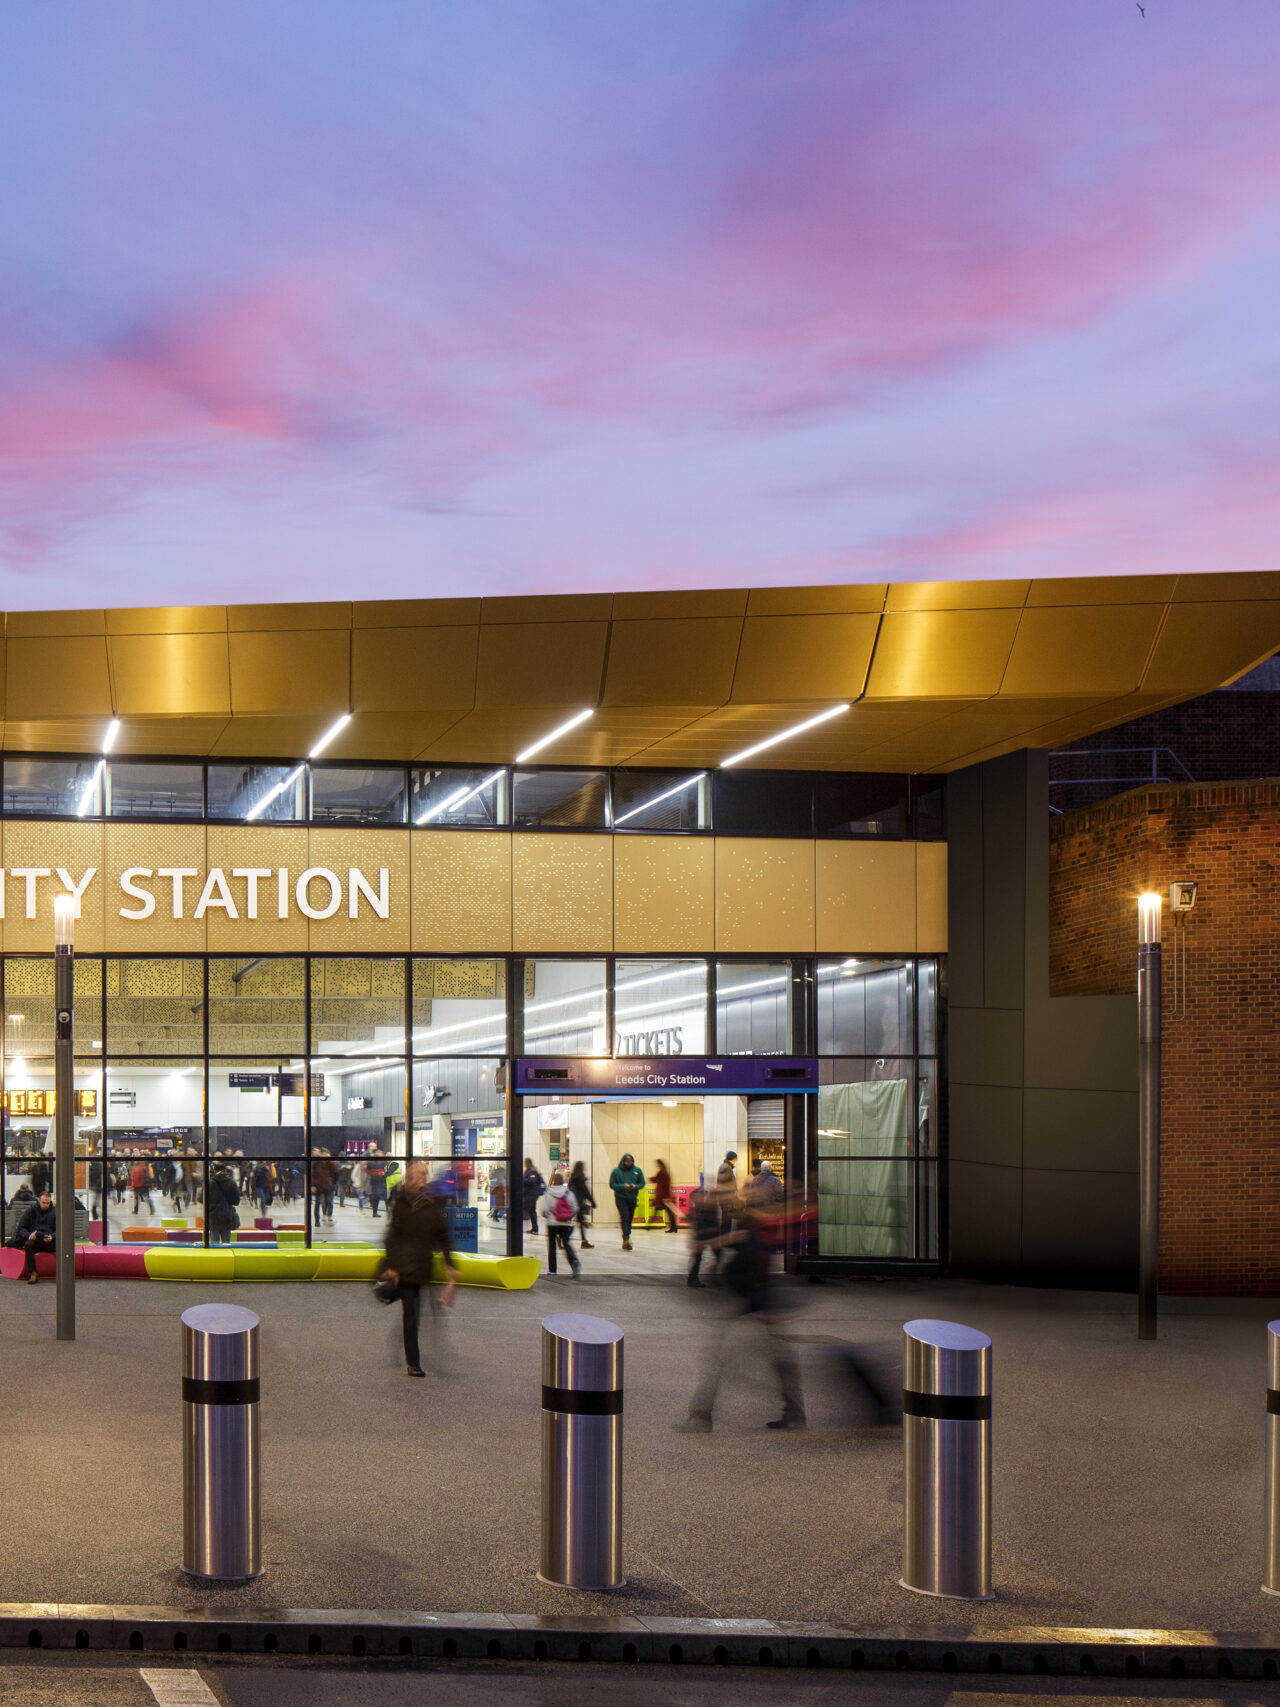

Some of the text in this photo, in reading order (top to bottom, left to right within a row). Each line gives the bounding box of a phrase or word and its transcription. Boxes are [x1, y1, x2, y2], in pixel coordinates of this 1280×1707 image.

[119, 866, 390, 919] STATION
[623, 1026, 684, 1055] TICKETS
[615, 1074, 706, 1086] Leeds City Station
